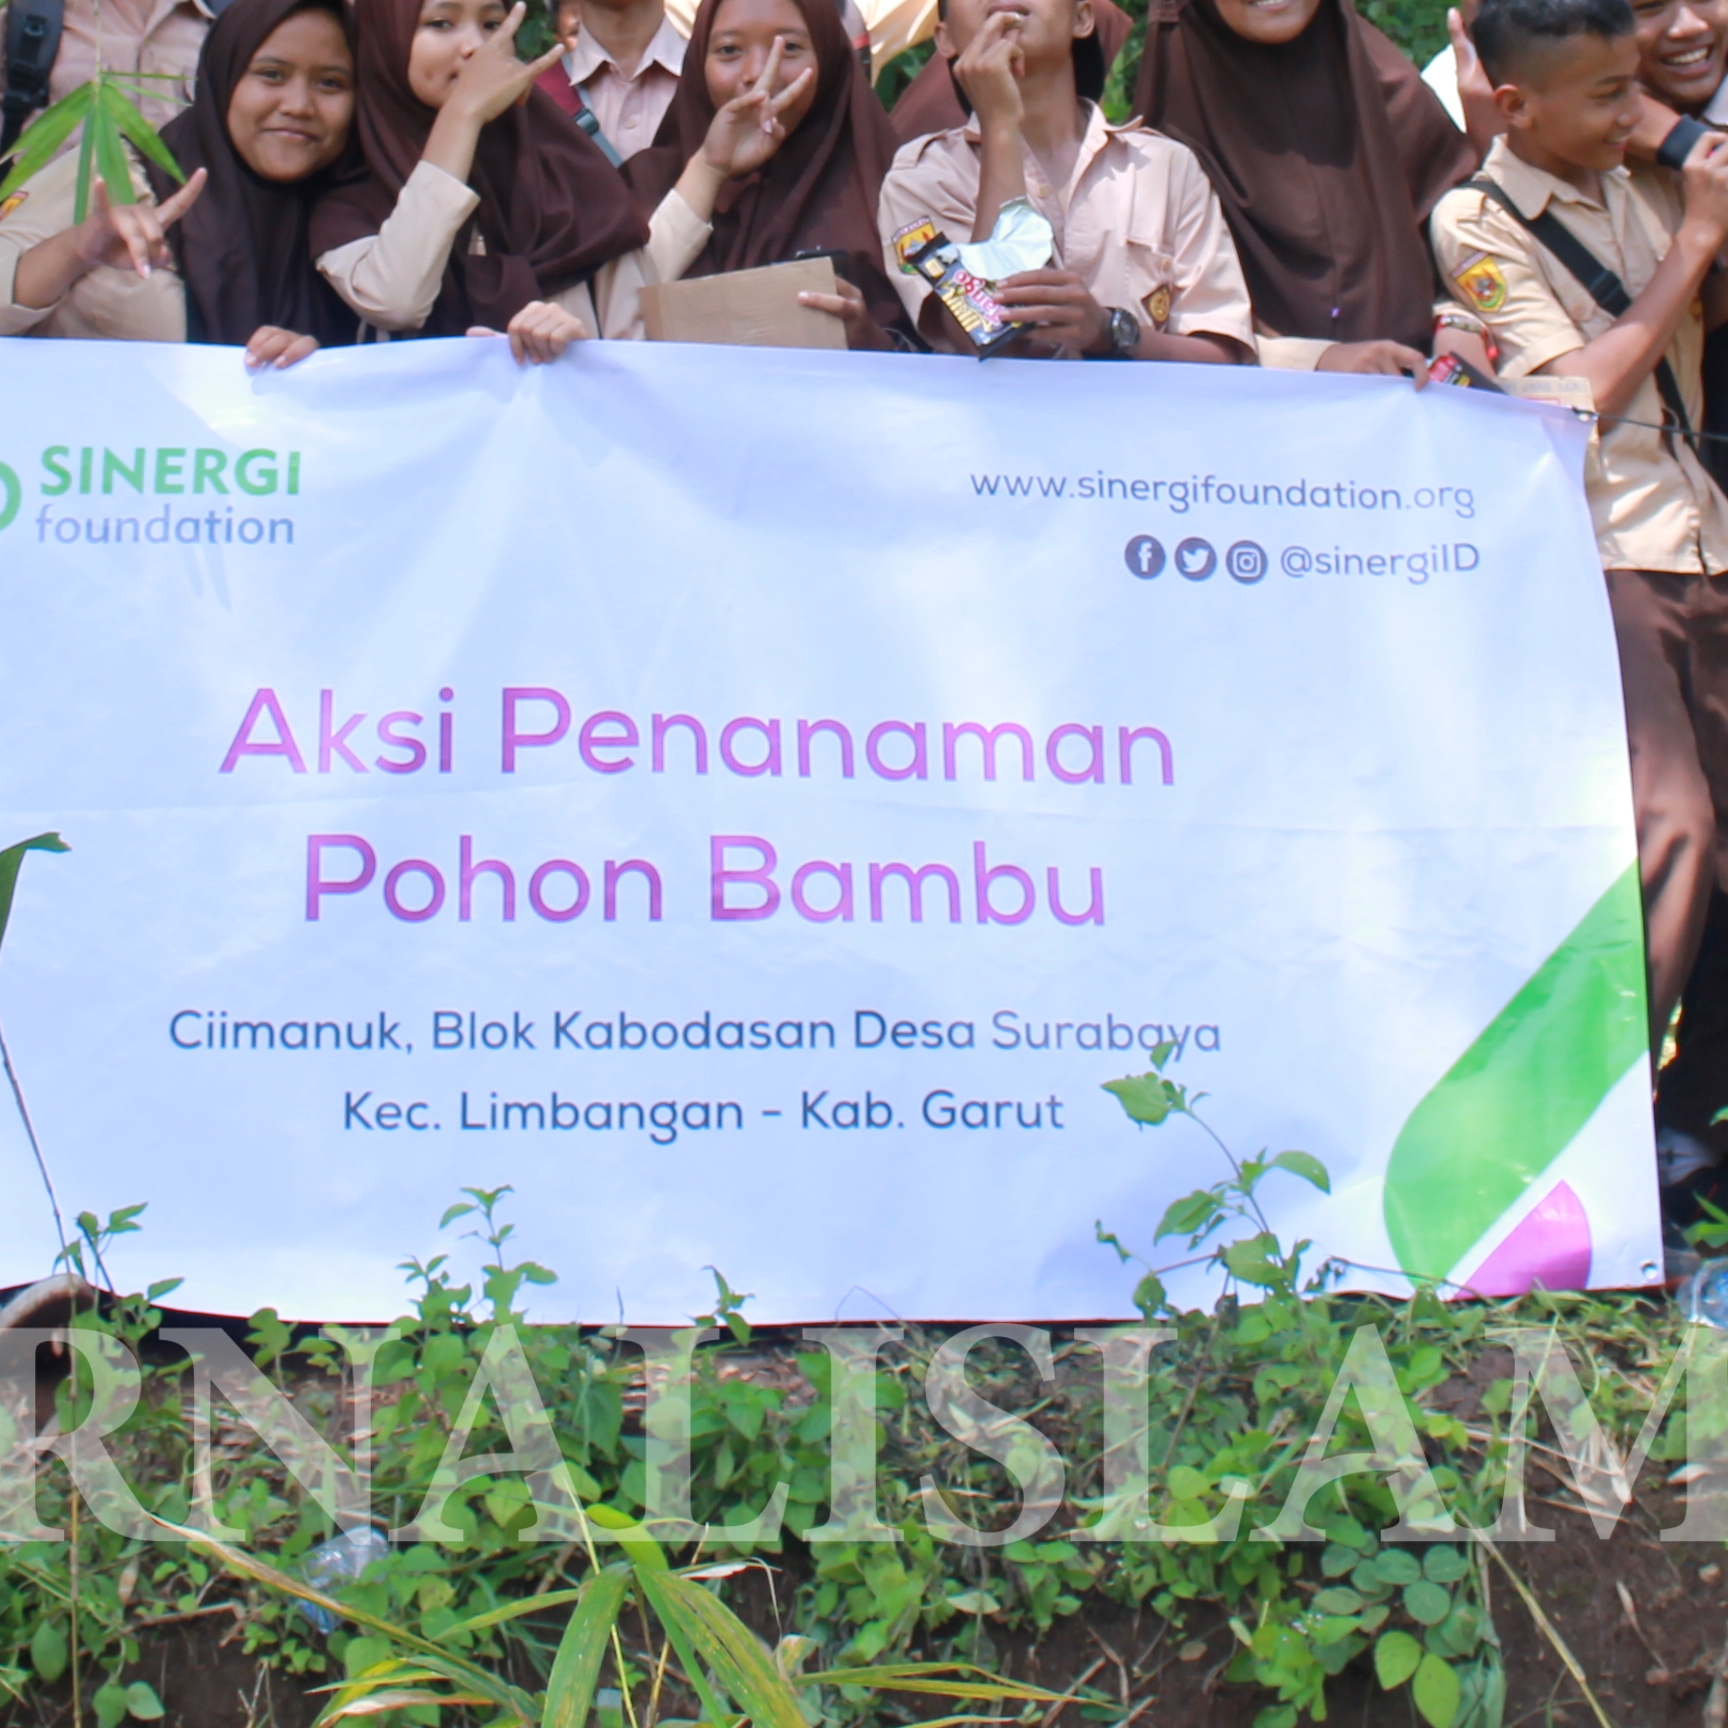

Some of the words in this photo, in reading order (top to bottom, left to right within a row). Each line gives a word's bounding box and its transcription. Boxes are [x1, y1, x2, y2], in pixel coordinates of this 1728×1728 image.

[40, 445, 301, 497] SINERGI
[971, 470, 1475, 518] www.sinergifoundation.org
[36, 504, 294, 544] foundation
[1280, 543, 1480, 585] @sinergiID
[219, 687, 454, 774] Aksi
[501, 686, 1174, 786] Penanaman
[305, 834, 662, 924] Pohon
[710, 834, 1105, 926] Bambu
[169, 1009, 413, 1055] Ciimanuk,
[432, 1010, 536, 1051] Blok
[554, 1010, 836, 1051] Kabodasan
[854, 1010, 975, 1051] Desa
[992, 1010, 1221, 1062] Surabaya
[344, 1091, 441, 1132] Kec.
[460, 1091, 744, 1145] Limbangan
[802, 1090, 905, 1131] Kab.
[922, 1089, 1065, 1130] Garut
